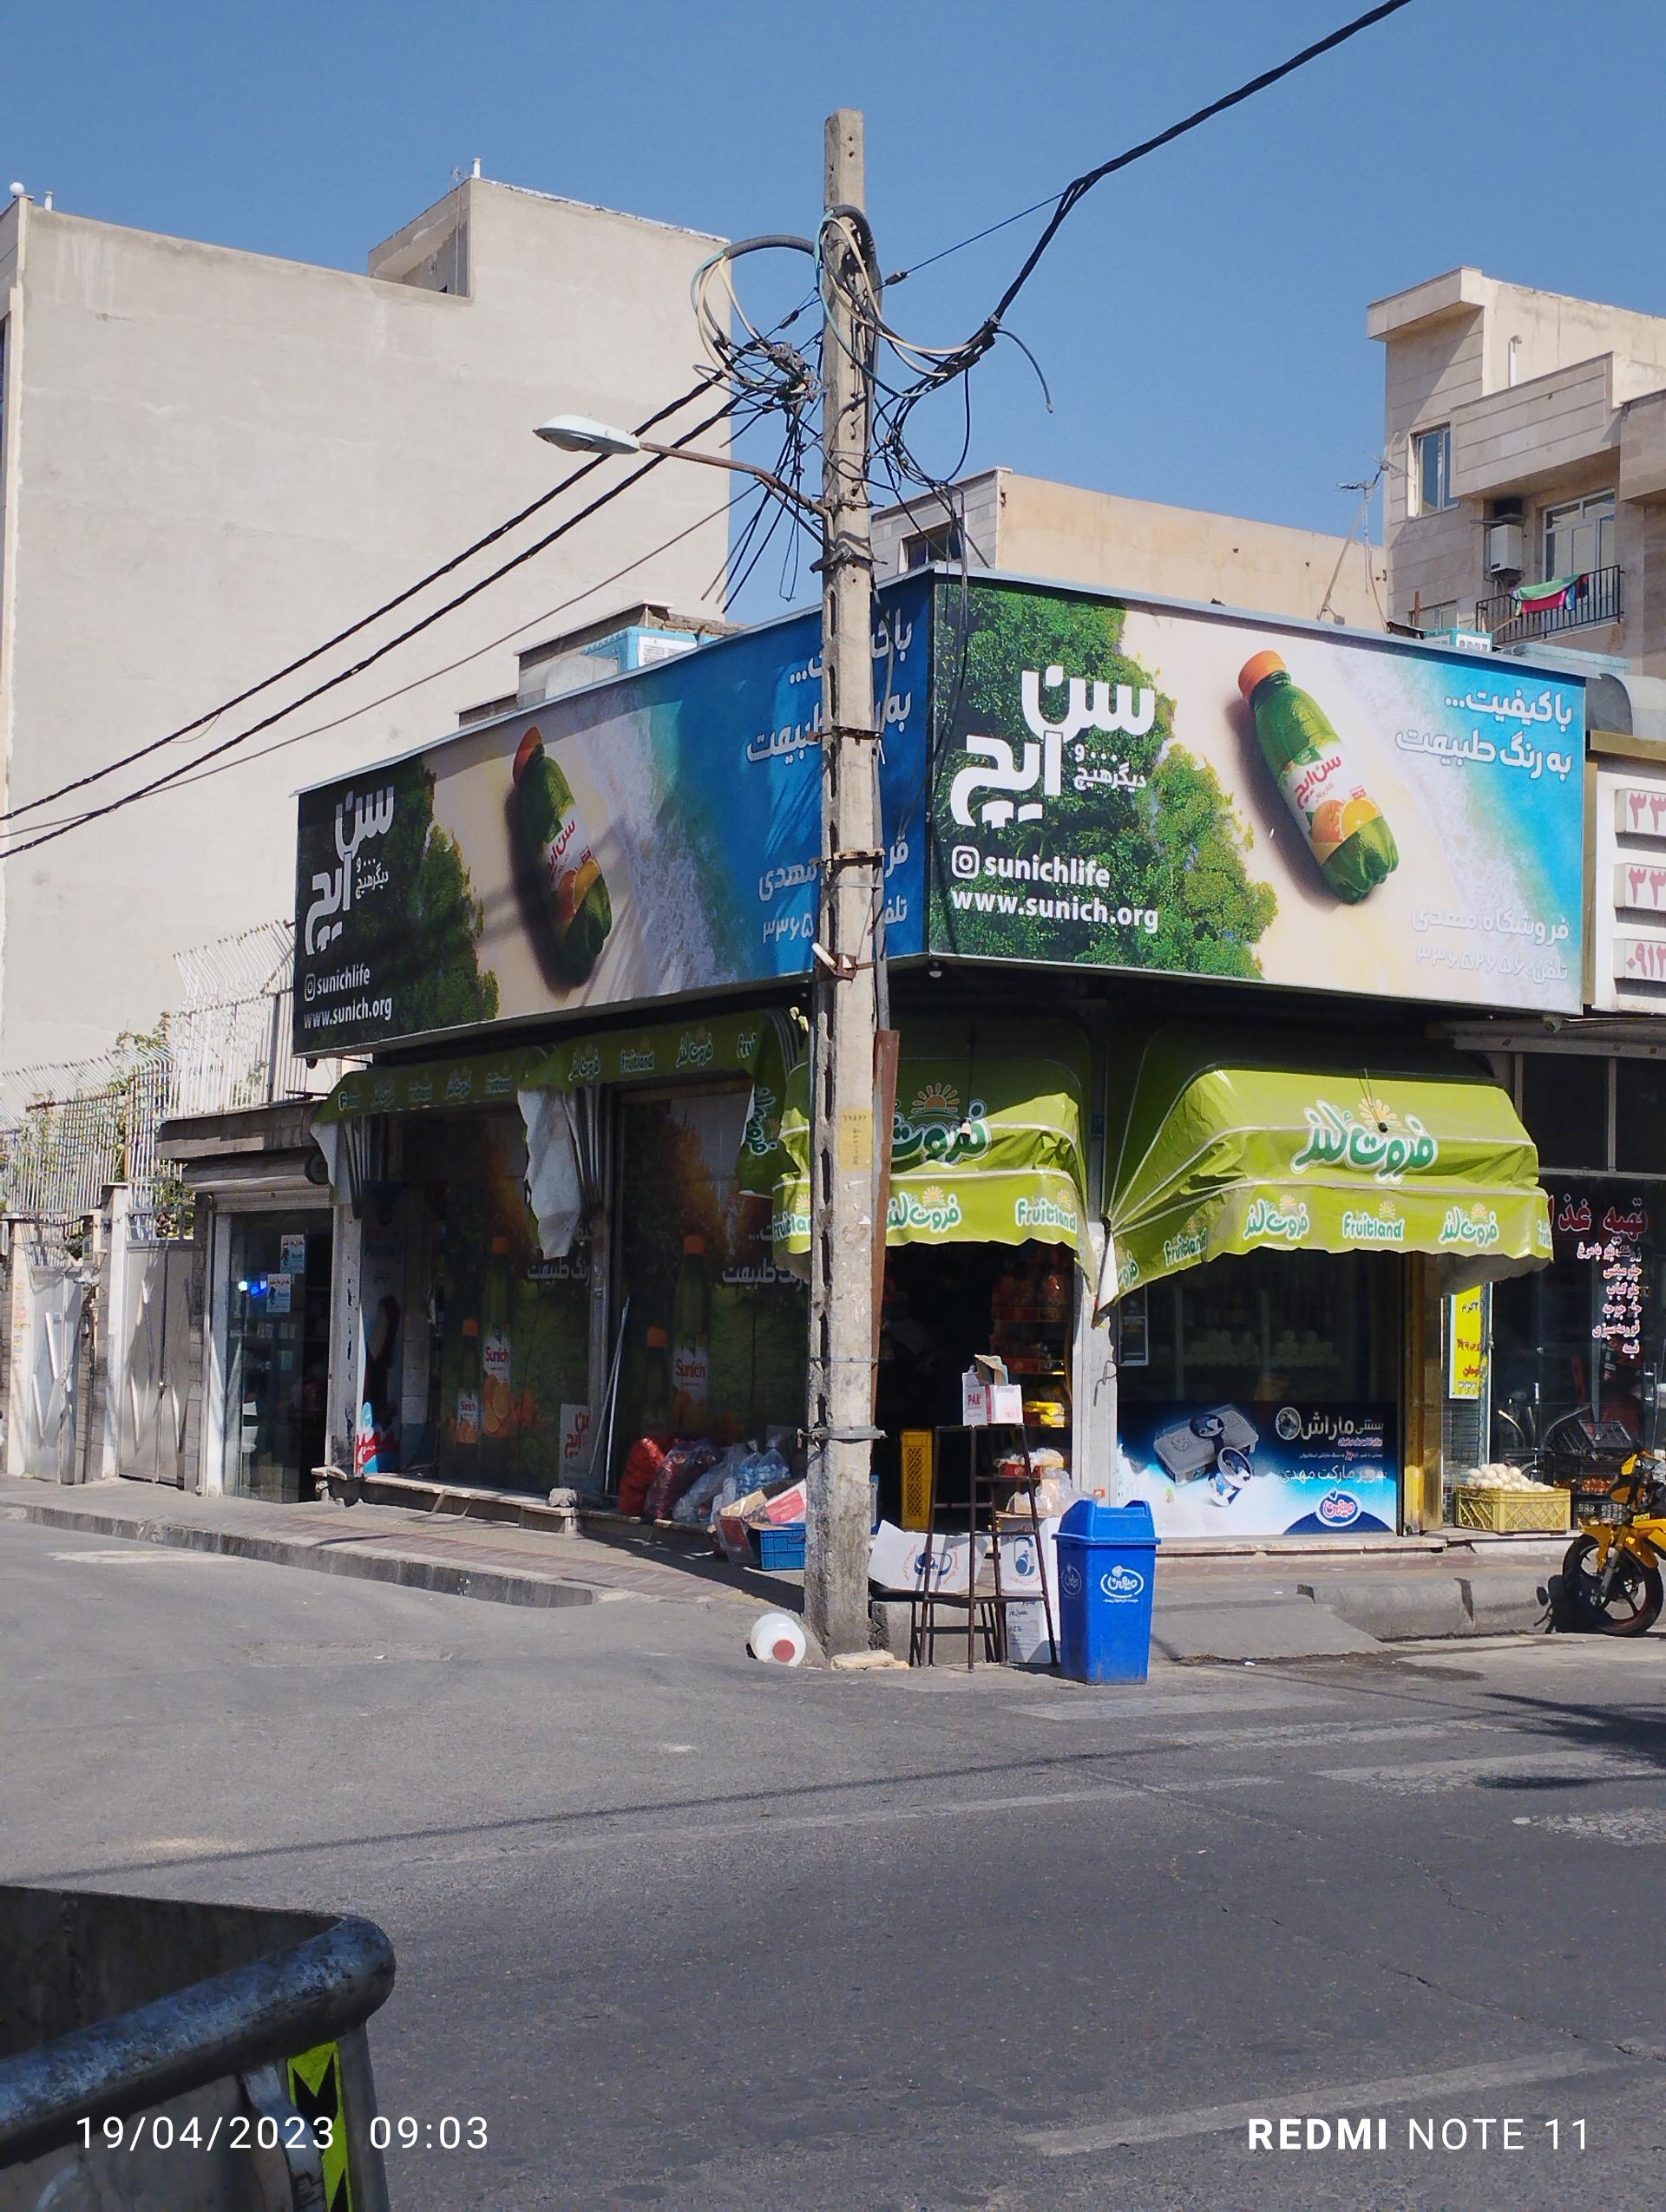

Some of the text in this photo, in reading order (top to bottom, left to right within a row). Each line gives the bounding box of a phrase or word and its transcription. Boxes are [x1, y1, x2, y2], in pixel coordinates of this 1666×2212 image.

[1394, 728, 1573, 782] به رنگ طبیعت
[984, 854, 1111, 888] sunichlife
[951, 886, 1159, 935] www.sunich.org
[1410, 909, 1478, 933] مهدی
[316, 961, 371, 997] sunichlife
[304, 997, 392, 1029] www.sunich.org
[1015, 1197, 1078, 1234] Fruitland
[1342, 1210, 1405, 1241] Fruitland
[721, 1256, 777, 1291] طبیعت
[485, 1345, 510, 1364] Sunich
[673, 1358, 706, 1381] Sunich
[1279, 1468, 1316, 1484] مهدی
